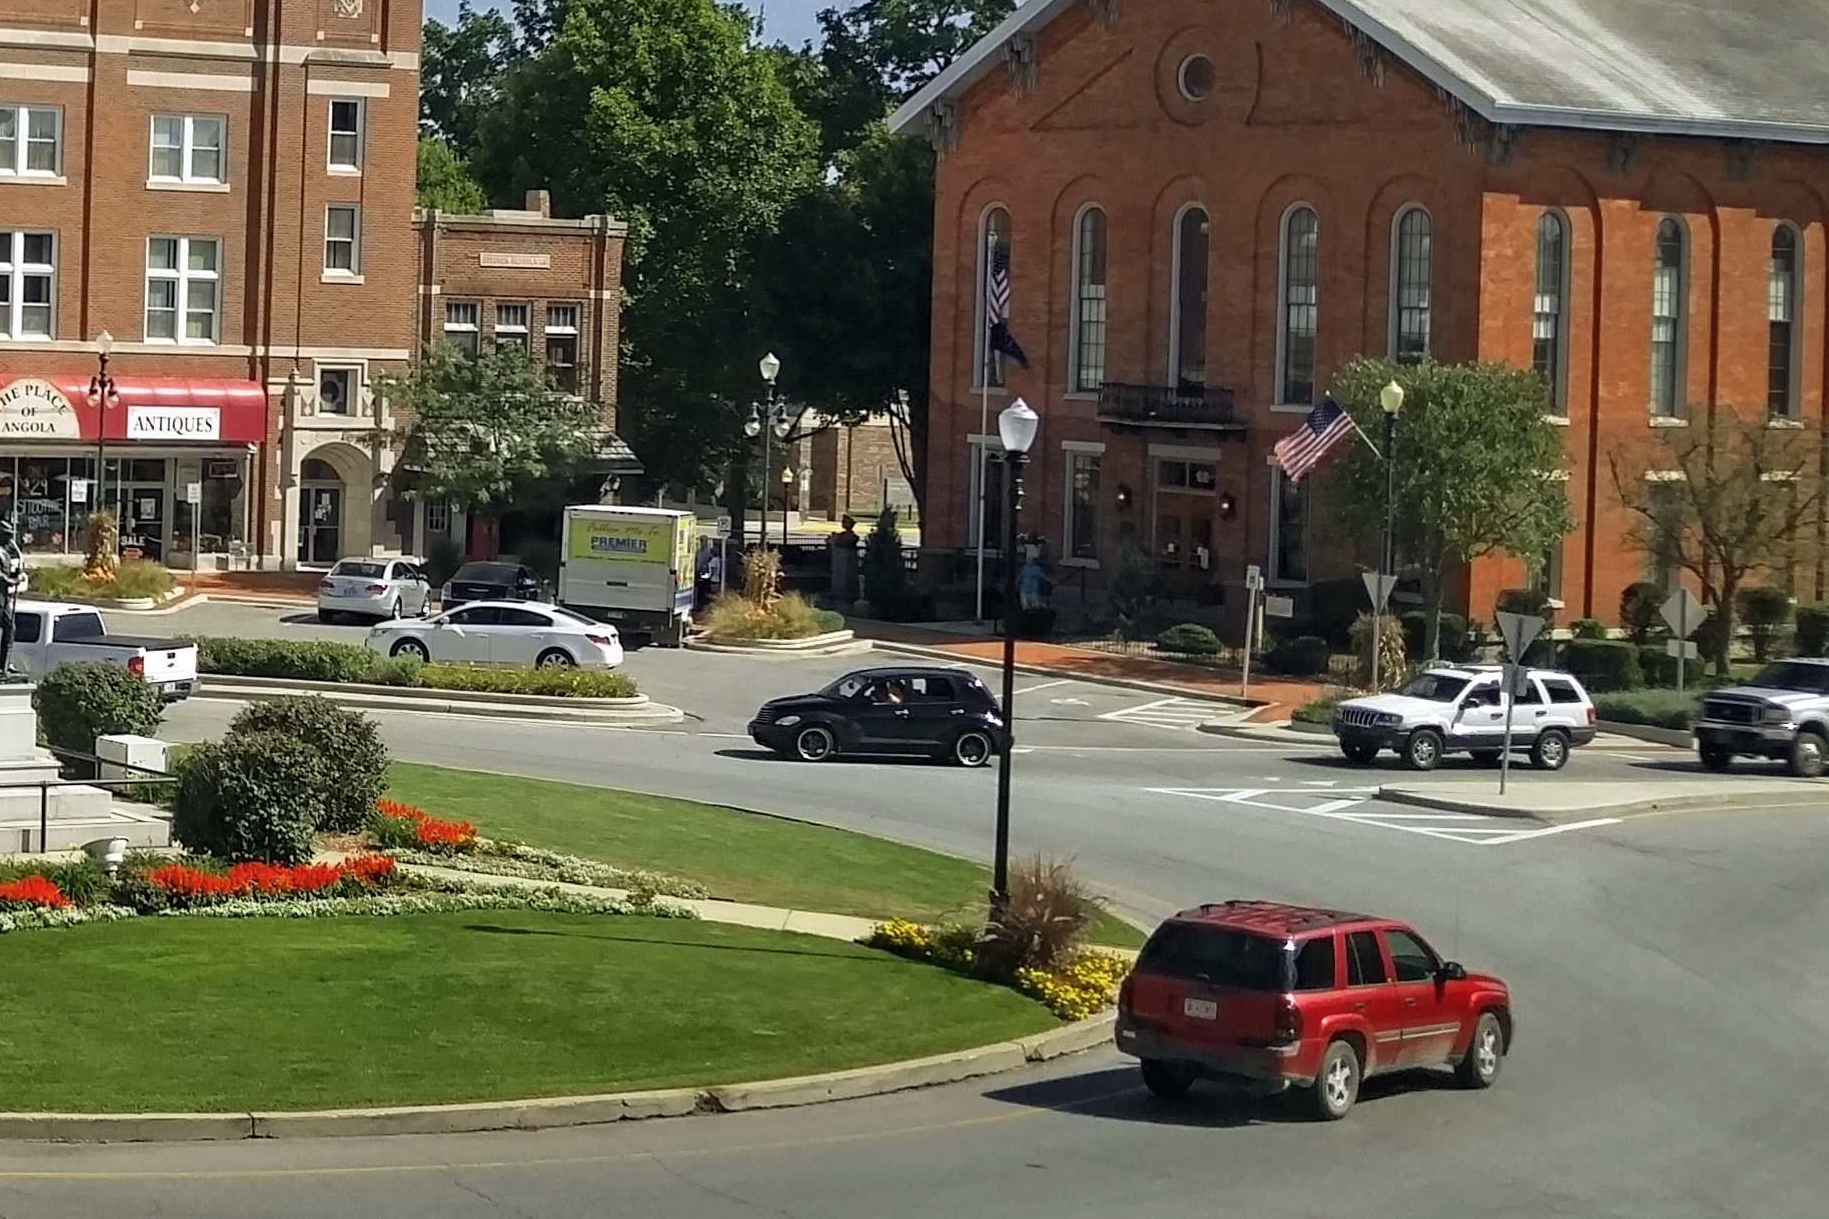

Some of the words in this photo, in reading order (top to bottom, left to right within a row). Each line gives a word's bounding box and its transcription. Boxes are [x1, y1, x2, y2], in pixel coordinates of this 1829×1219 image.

[25, 385, 68, 416] PLACE
[21, 406, 38, 418] OF
[2, 422, 56, 433] ANGOLA
[134, 416, 213, 436] ANTIQUES
[28, 514, 50, 530] BAR
[120, 535, 145, 546] SALE
[591, 537, 647, 549] PREMIER
